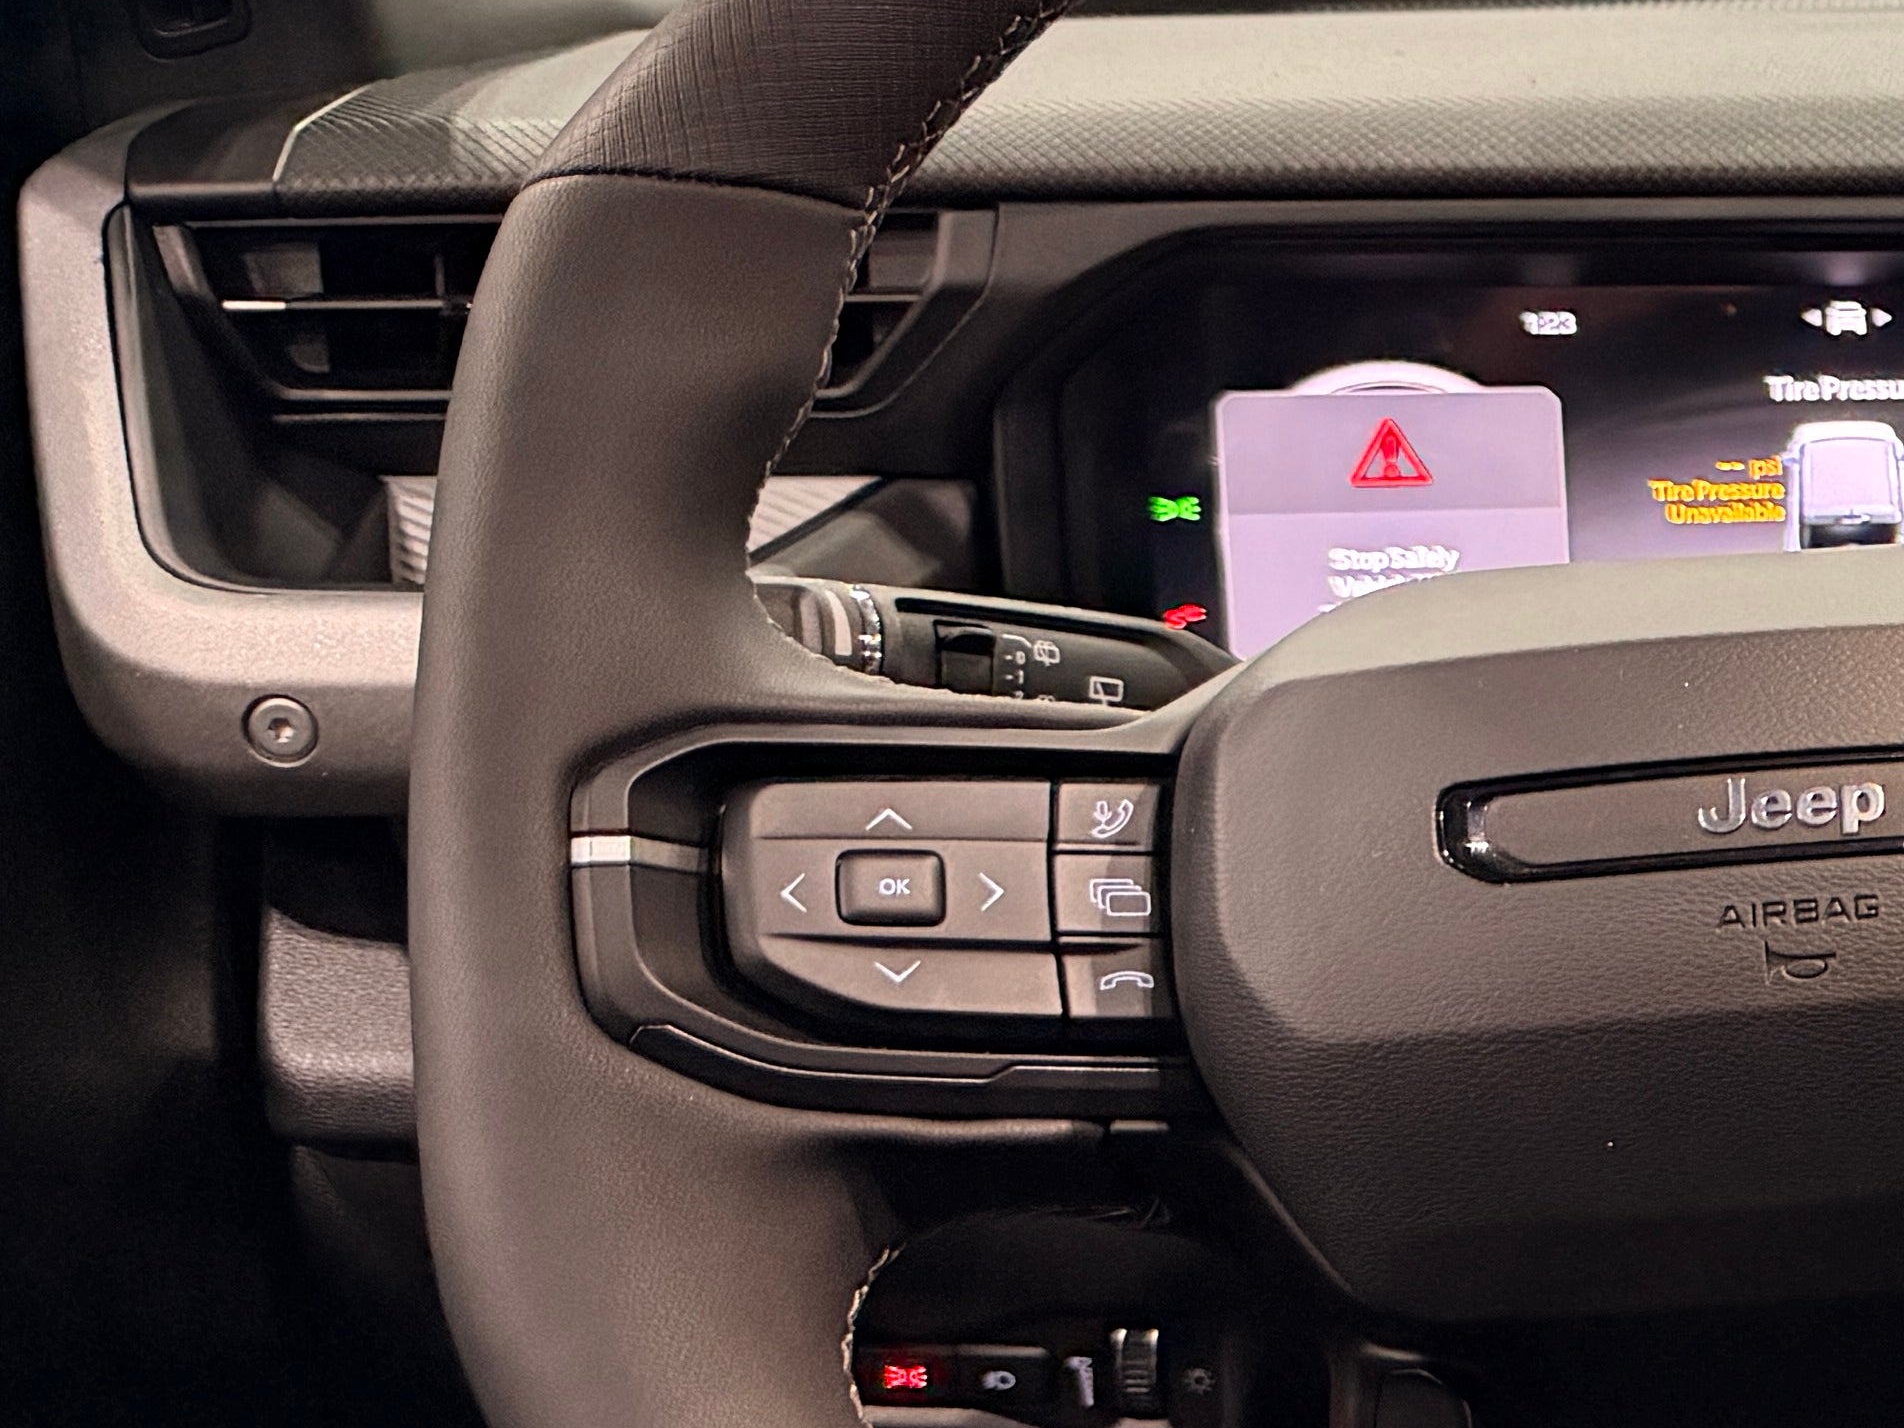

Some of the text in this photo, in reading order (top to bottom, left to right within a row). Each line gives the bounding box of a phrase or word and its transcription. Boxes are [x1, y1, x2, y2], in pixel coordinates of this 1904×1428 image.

[1520, 311, 1577, 335] 1:23
[1765, 376, 1820, 402] Tire
[1749, 457, 1784, 479] psi
[1649, 479, 1785, 502] Tire Pressure
[1666, 500, 1786, 524] Unavailable
[1328, 547, 1389, 572] Stop
[1698, 777, 1886, 836] Jeep
[878, 878, 911, 895] OK
[1715, 893, 1881, 930] AIRBAG
